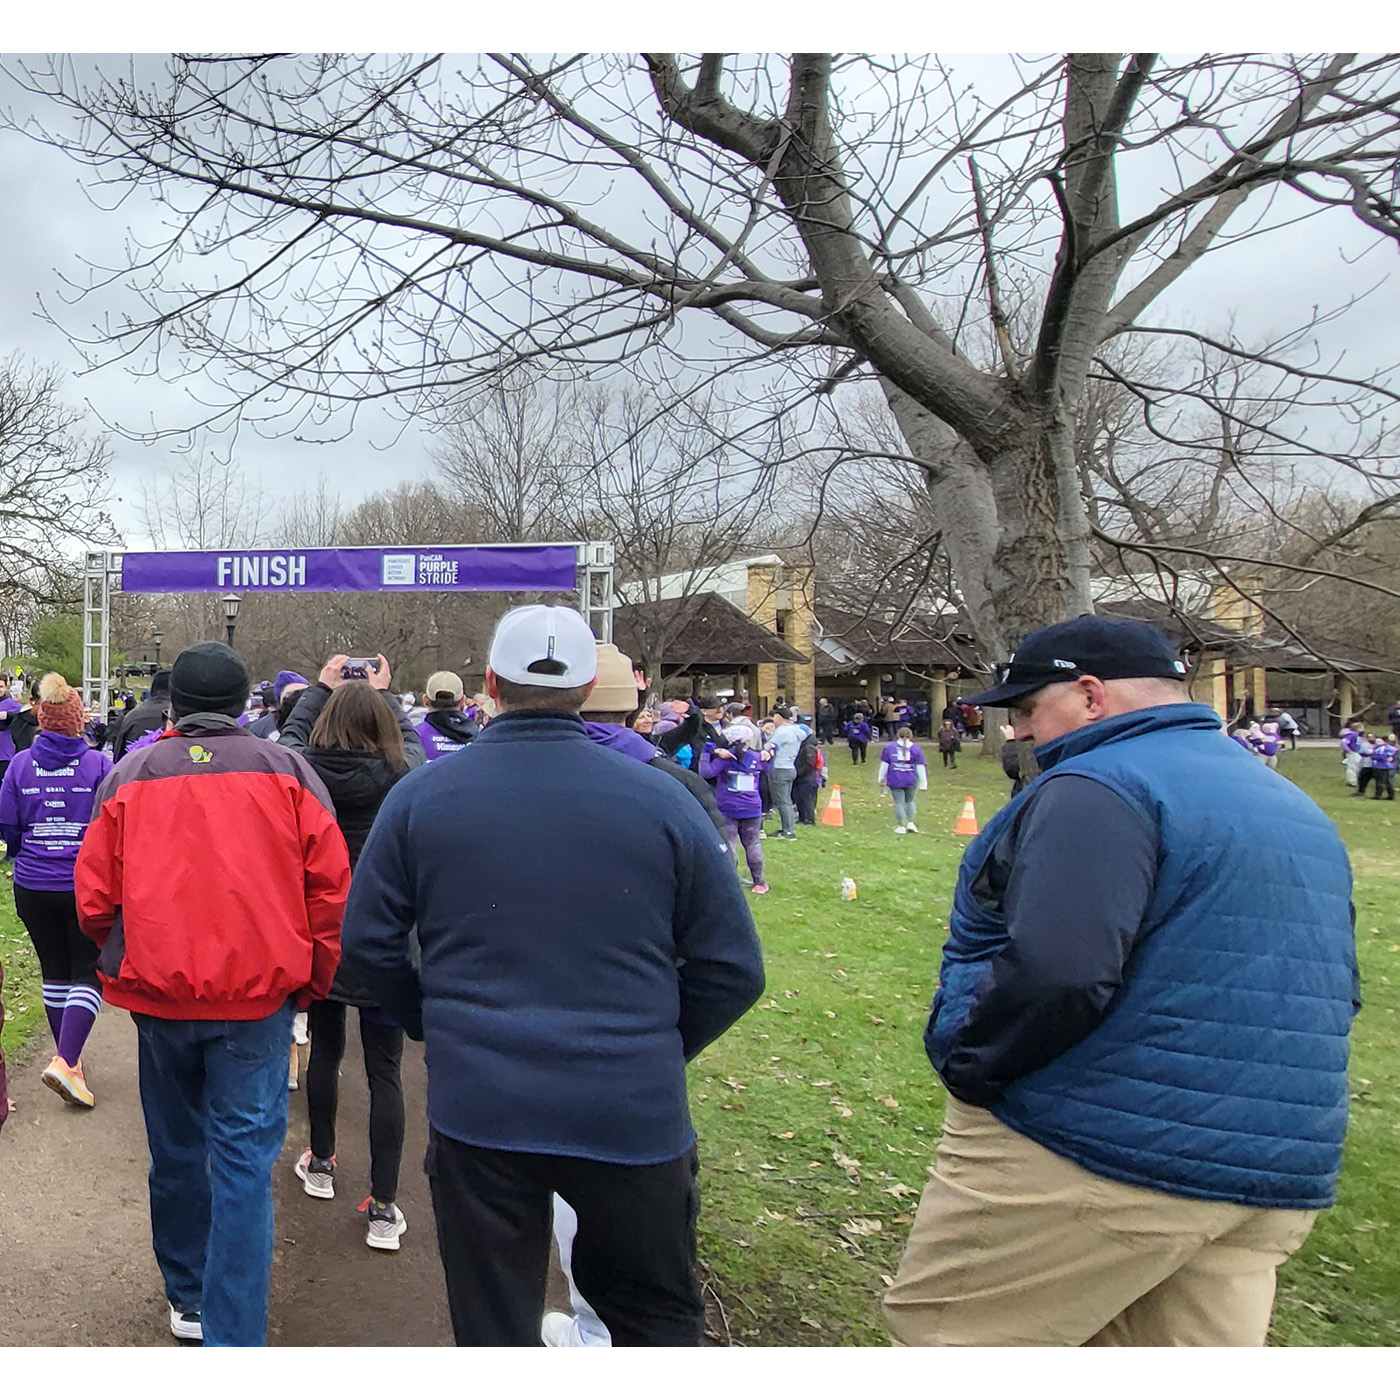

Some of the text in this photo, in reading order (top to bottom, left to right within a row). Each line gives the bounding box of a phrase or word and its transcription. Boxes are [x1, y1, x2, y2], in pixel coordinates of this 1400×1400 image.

[218, 555, 306, 586] FINISH
[419, 561, 459, 572] PURPLE
[419, 572, 459, 584] STRIDE
